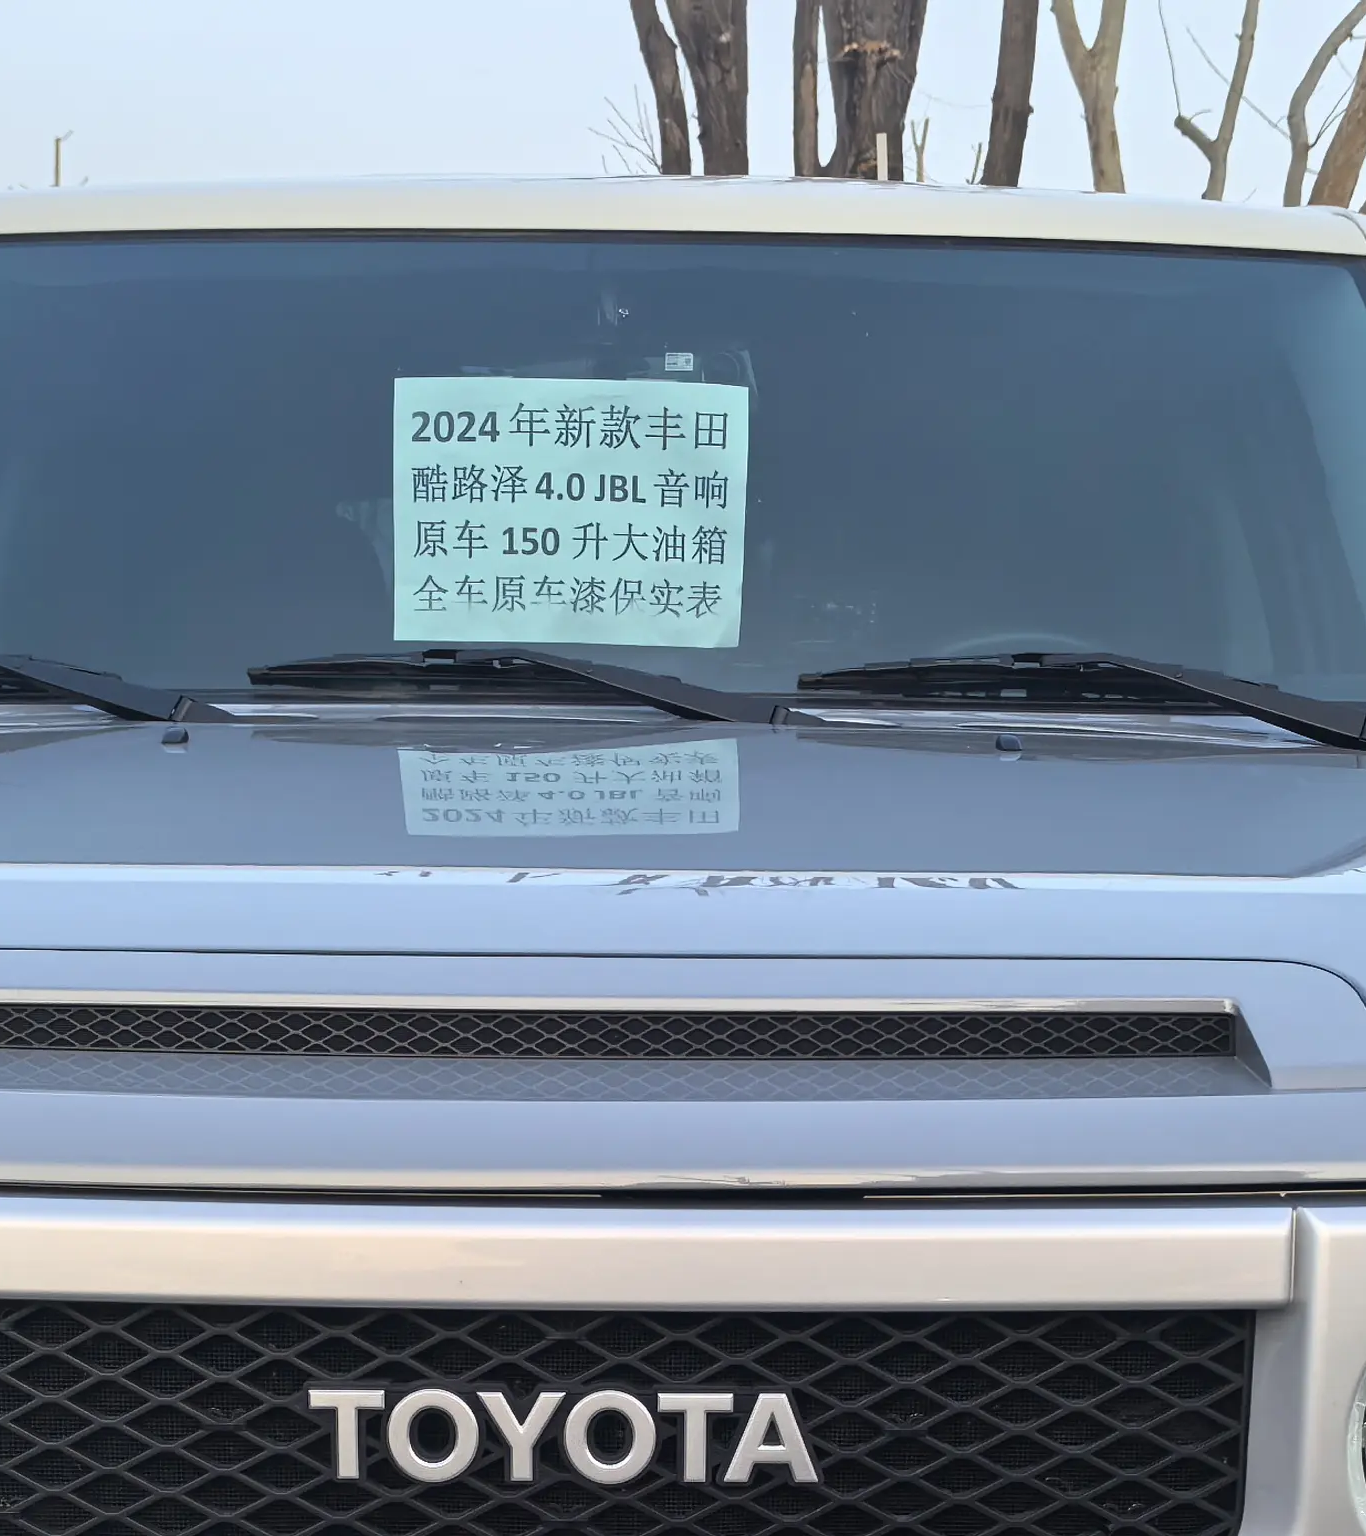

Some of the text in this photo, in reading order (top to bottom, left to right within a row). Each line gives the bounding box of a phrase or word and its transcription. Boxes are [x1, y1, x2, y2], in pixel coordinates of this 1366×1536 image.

[411, 402, 729, 451] 2024 年新款丰田
[411, 463, 729, 510] 酷路泽 4.0 JBL 音响
[413, 519, 728, 565] 原车 150 升大油箱
[413, 574, 723, 619] 全车原车漆保实表
[307, 1388, 819, 1485] TOYOTA
